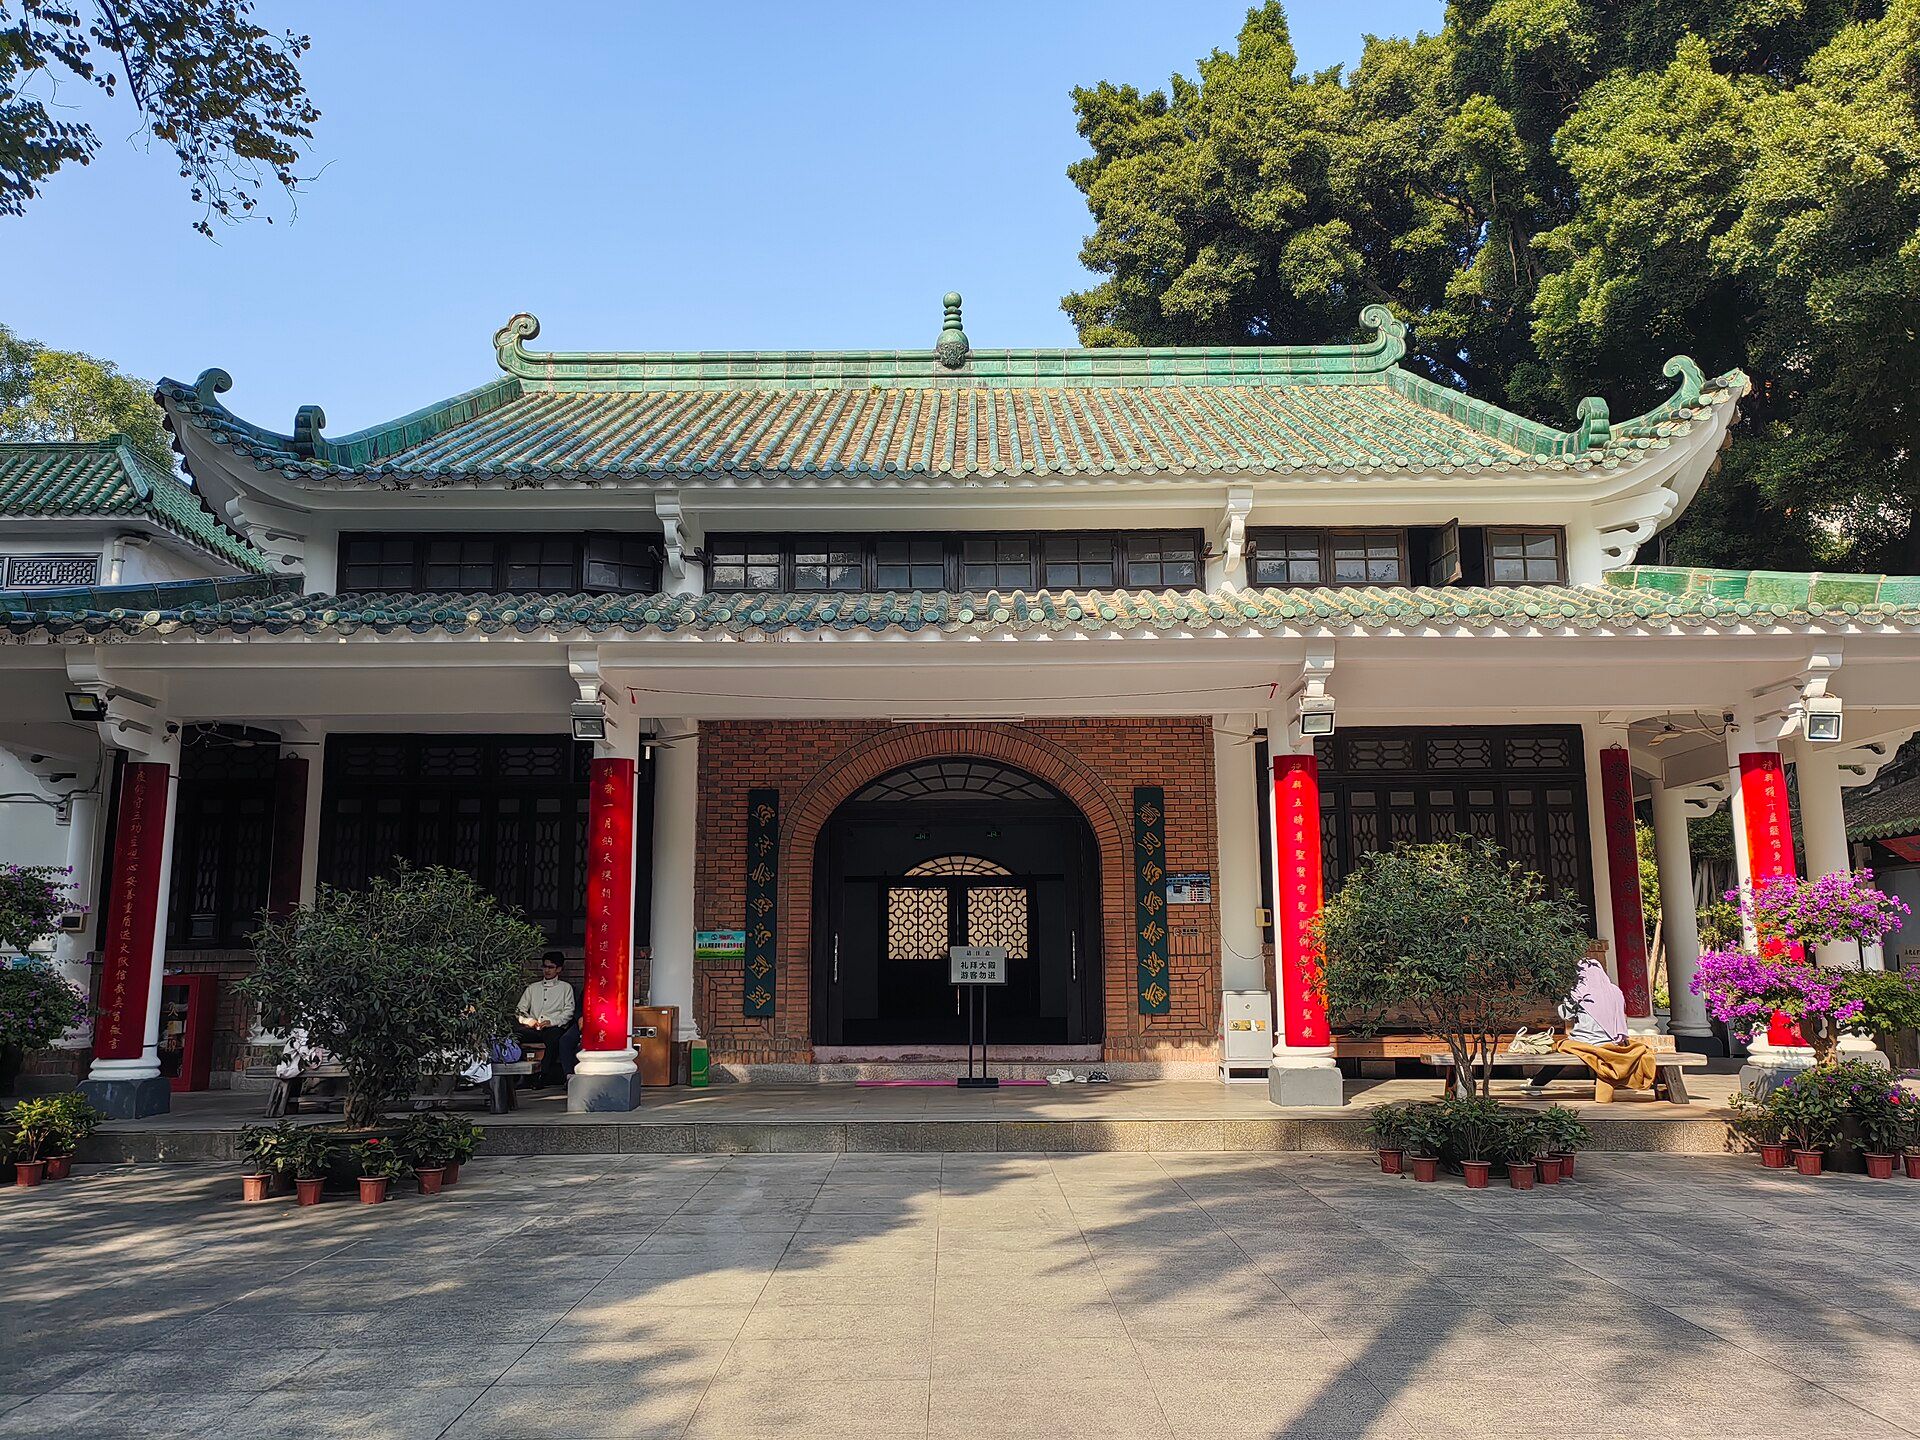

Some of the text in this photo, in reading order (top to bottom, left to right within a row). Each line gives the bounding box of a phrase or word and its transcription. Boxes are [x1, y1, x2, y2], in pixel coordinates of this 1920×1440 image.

[960, 961, 996, 970] 礼拜大殿
[960, 971, 996, 980] 游客勿进
